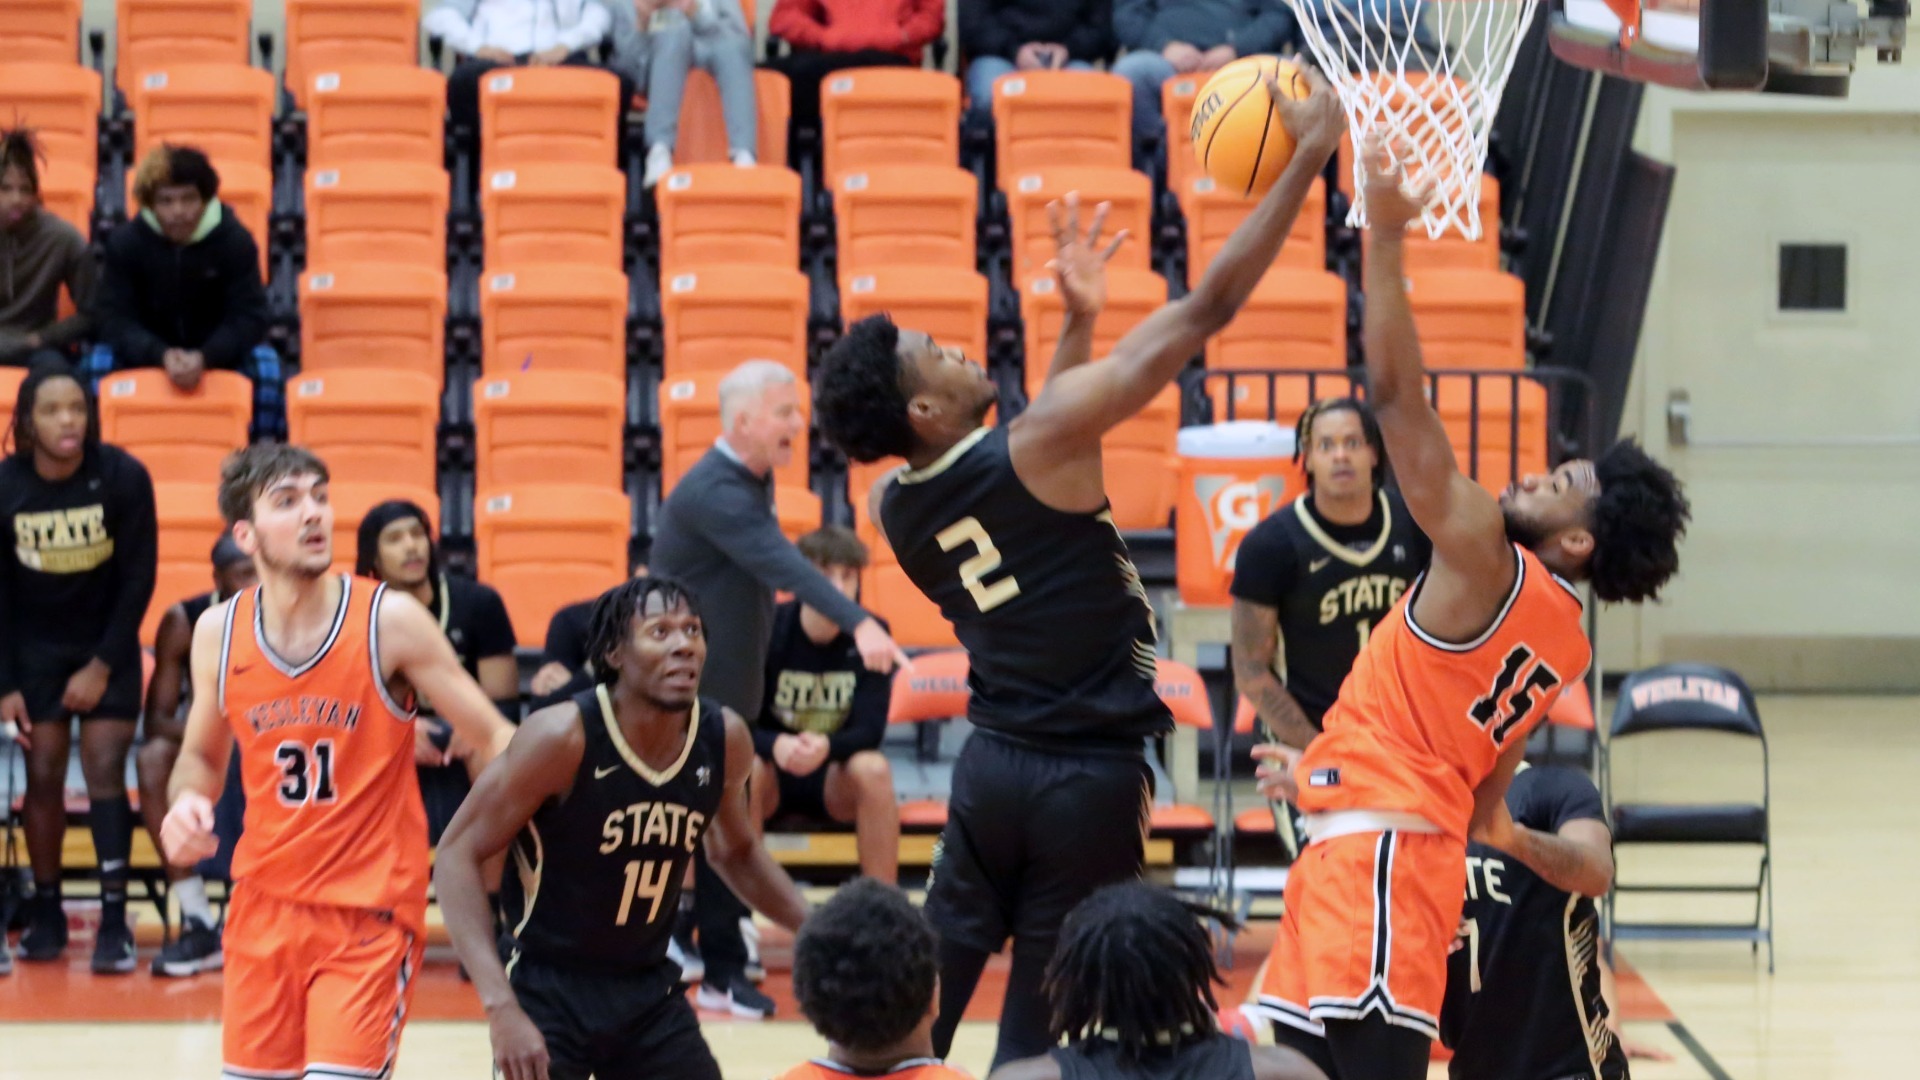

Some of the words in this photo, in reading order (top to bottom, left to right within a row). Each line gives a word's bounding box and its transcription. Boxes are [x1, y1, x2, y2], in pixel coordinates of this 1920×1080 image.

[14, 503, 108, 549] STATE
[1219, 483, 1260, 528] G
[934, 515, 1021, 613] 2
[244, 695, 362, 735] WESLEYAN
[775, 670, 857, 712] STATE
[1467, 640, 1562, 751] 15
[1631, 675, 1740, 713] WESLEYAN
[273, 738, 338, 807] 31
[599, 801, 705, 856] STATE
[615, 860, 673, 926] 14
